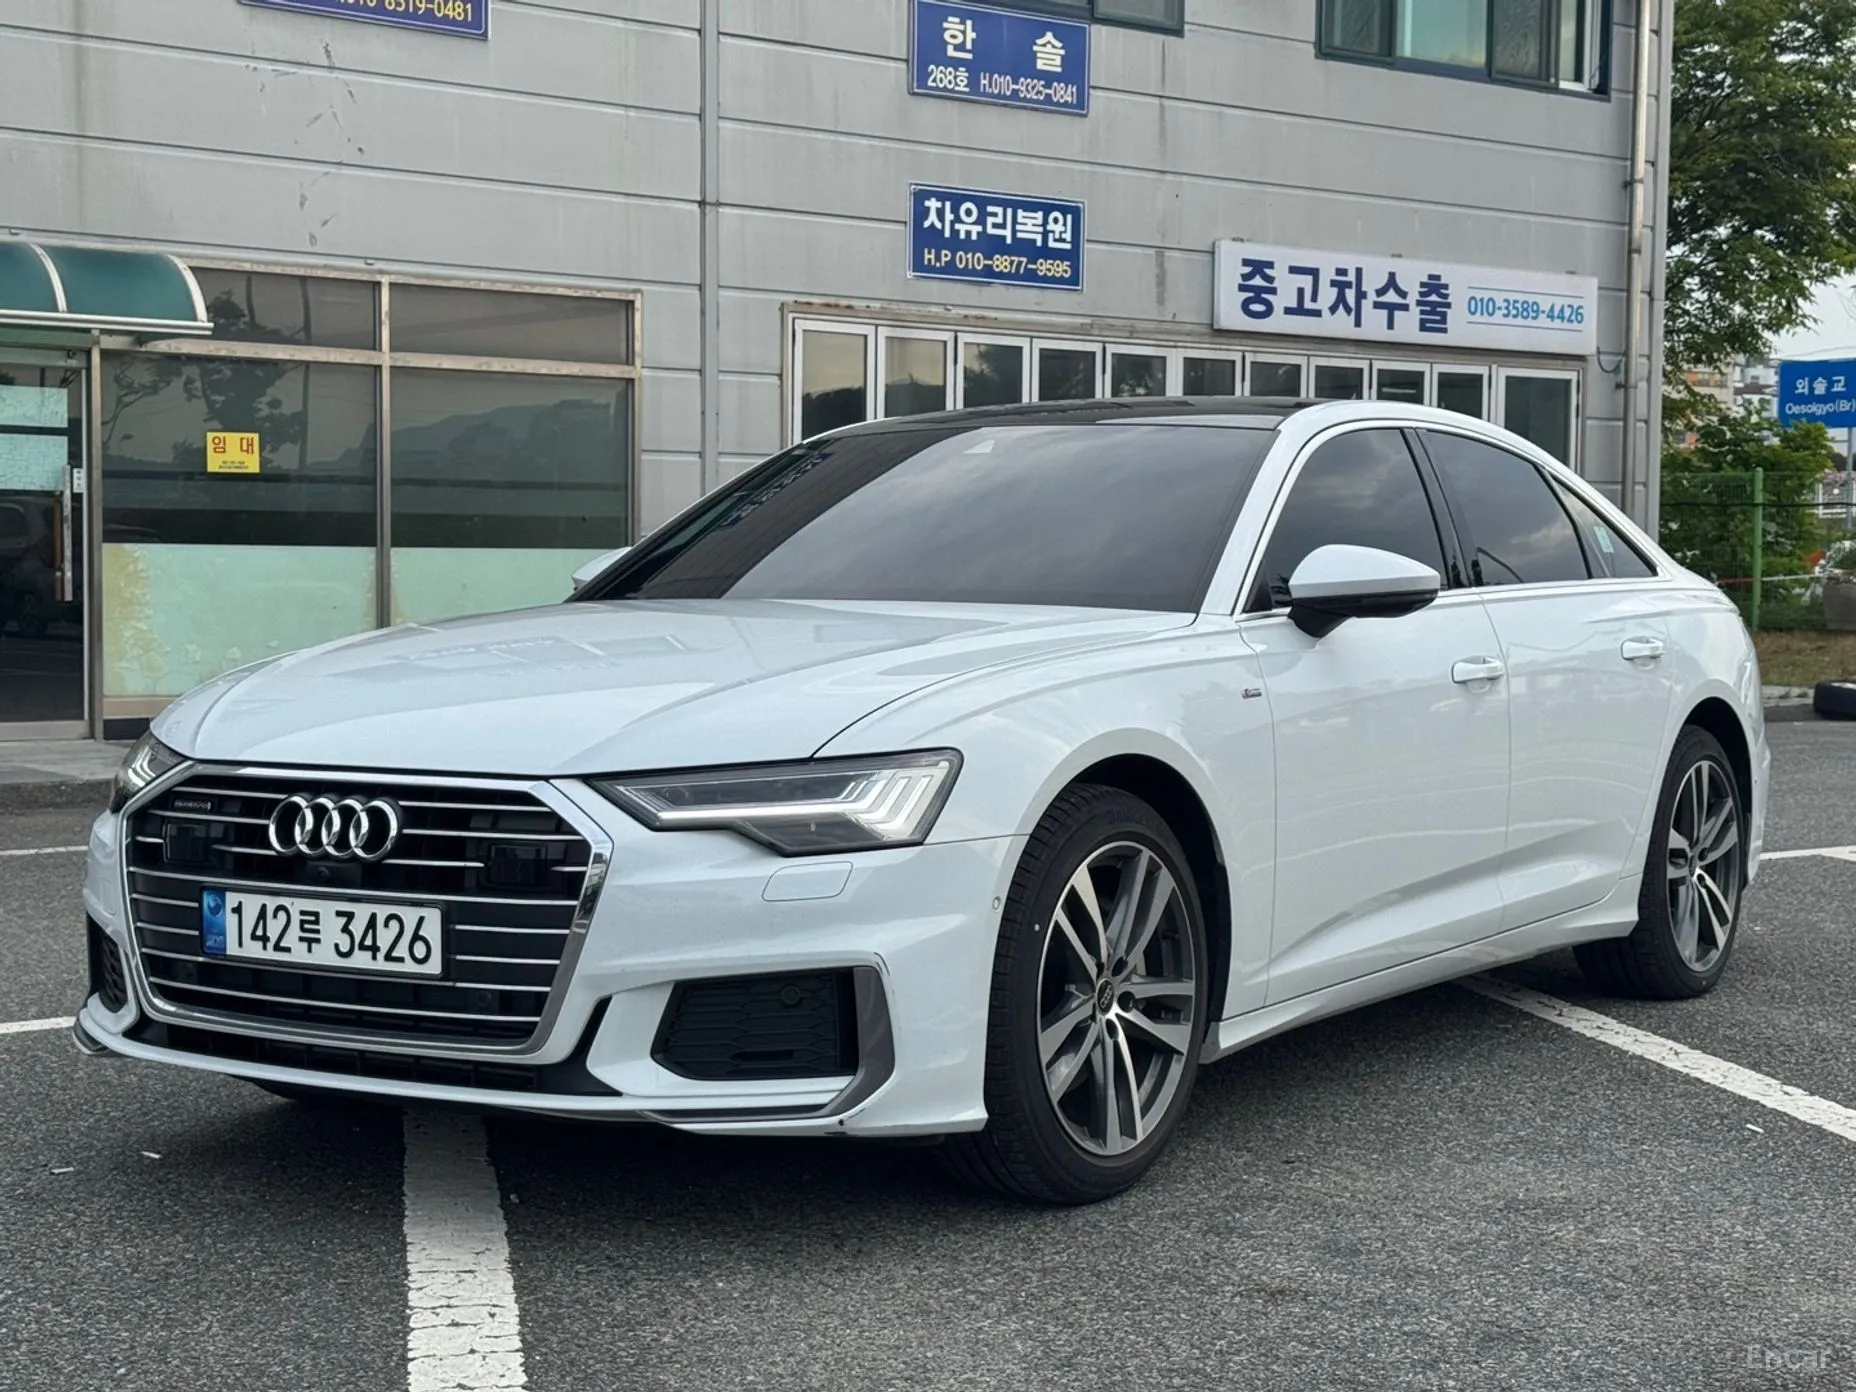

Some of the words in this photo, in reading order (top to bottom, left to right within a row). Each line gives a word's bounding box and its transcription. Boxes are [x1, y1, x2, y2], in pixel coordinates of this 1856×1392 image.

[942, 16, 977, 60] 한
[1032, 31, 1066, 73] 솔
[927, 64, 970, 93] 268호
[979, 72, 1077, 105] H.010-9325-0841
[923, 197, 1073, 250] 차유리복원
[923, 248, 952, 268] H.P
[955, 251, 1072, 278] 010-8877-9595
[1236, 257, 1453, 335] 중고차수출
[1467, 295, 1585, 325] 010-3589-4426
[1794, 375, 1848, 396] 외솔교
[211, 435, 227, 454] 임
[239, 436, 255, 455] 대
[230, 900, 322, 954] 142루
[333, 909, 432, 965] 3426
